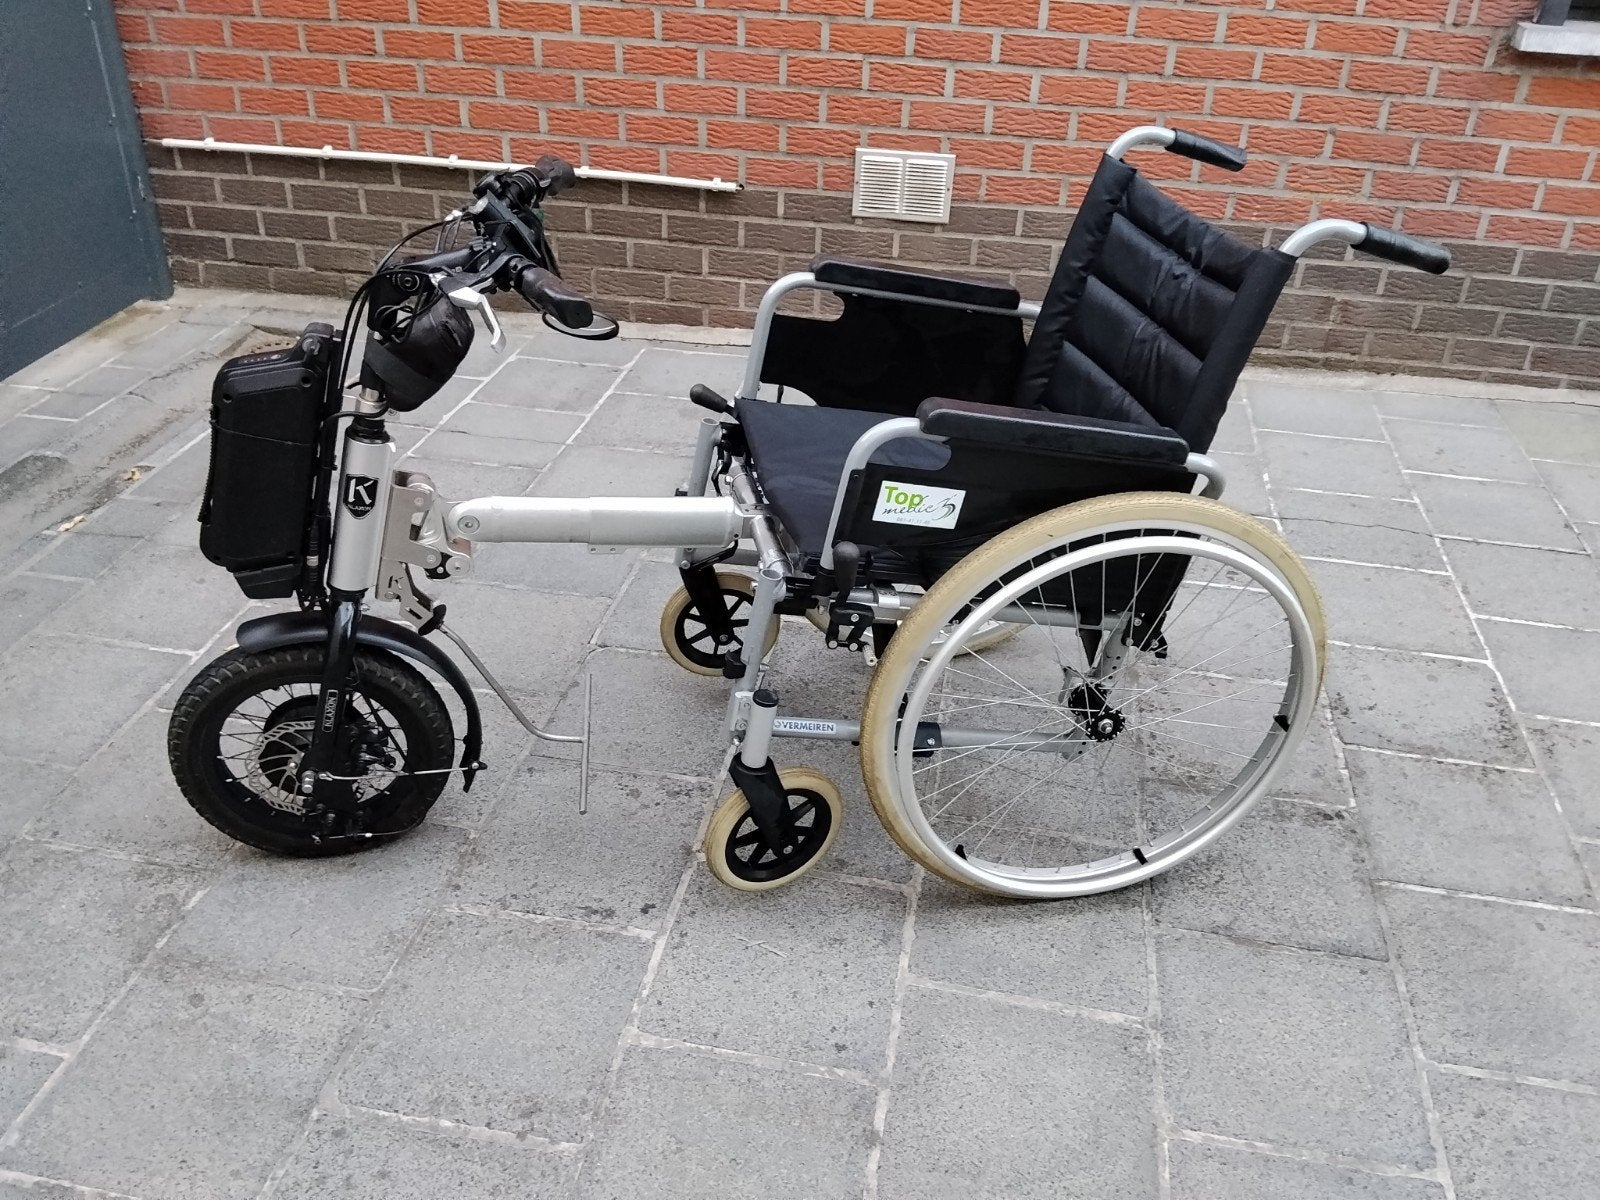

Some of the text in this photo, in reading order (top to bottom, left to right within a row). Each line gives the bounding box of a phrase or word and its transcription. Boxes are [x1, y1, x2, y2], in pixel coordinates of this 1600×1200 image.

[348, 478, 374, 505] K
[885, 486, 923, 509] Top
[882, 495, 935, 514] medic
[782, 721, 834, 732] VERMEIREN
